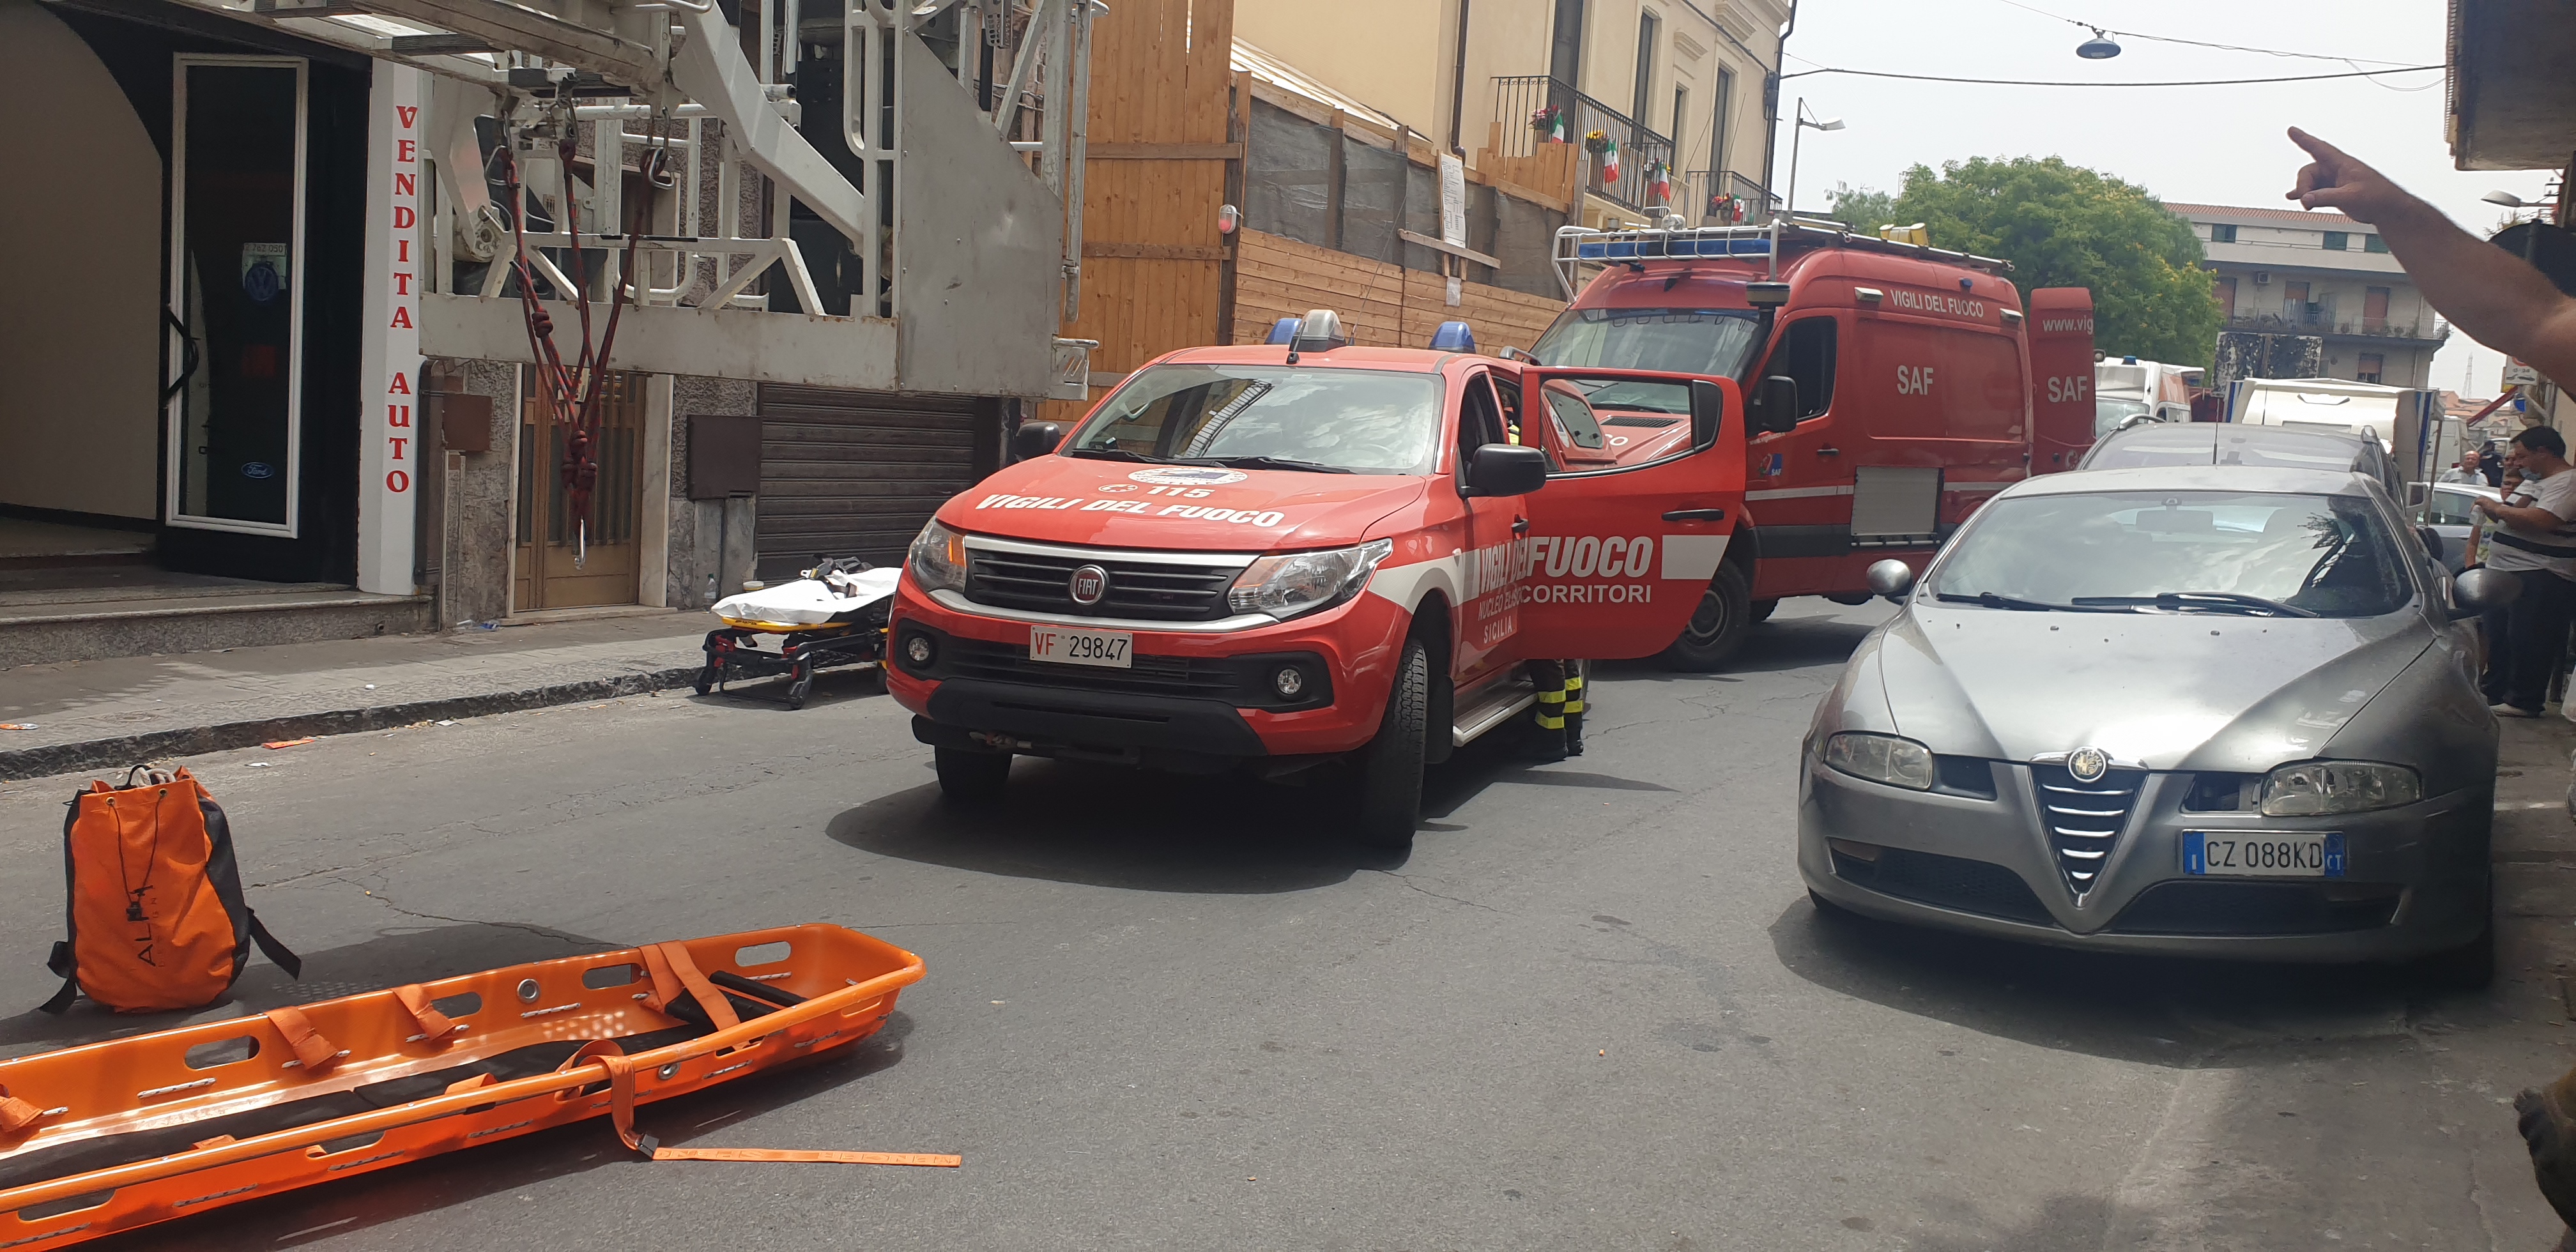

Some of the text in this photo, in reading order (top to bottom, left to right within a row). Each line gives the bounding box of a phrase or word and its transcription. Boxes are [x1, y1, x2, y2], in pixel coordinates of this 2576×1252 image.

[387, 106, 417, 492] VENDITA AUTO
[1890, 289, 1984, 318] VIGILI DEL FUOCO
[1897, 365, 1934, 395] SAF
[2047, 376, 2088, 402] SAF
[1147, 485, 1216, 498] 115
[975, 494, 1285, 528] VIGILI DEL FUOCO
[1480, 542, 1511, 594] VIGILI
[1527, 535, 1654, 578] FUOCO
[1077, 577, 1099, 595] FIAT
[1478, 593, 1504, 622] NUCLEO
[1483, 615, 1513, 644] SICILIA
[1034, 632, 1128, 661] VF 29847
[2206, 841, 2236, 867] CZ
[2245, 841, 2323, 869] 088KD
[2327, 854, 2342, 871] CT
